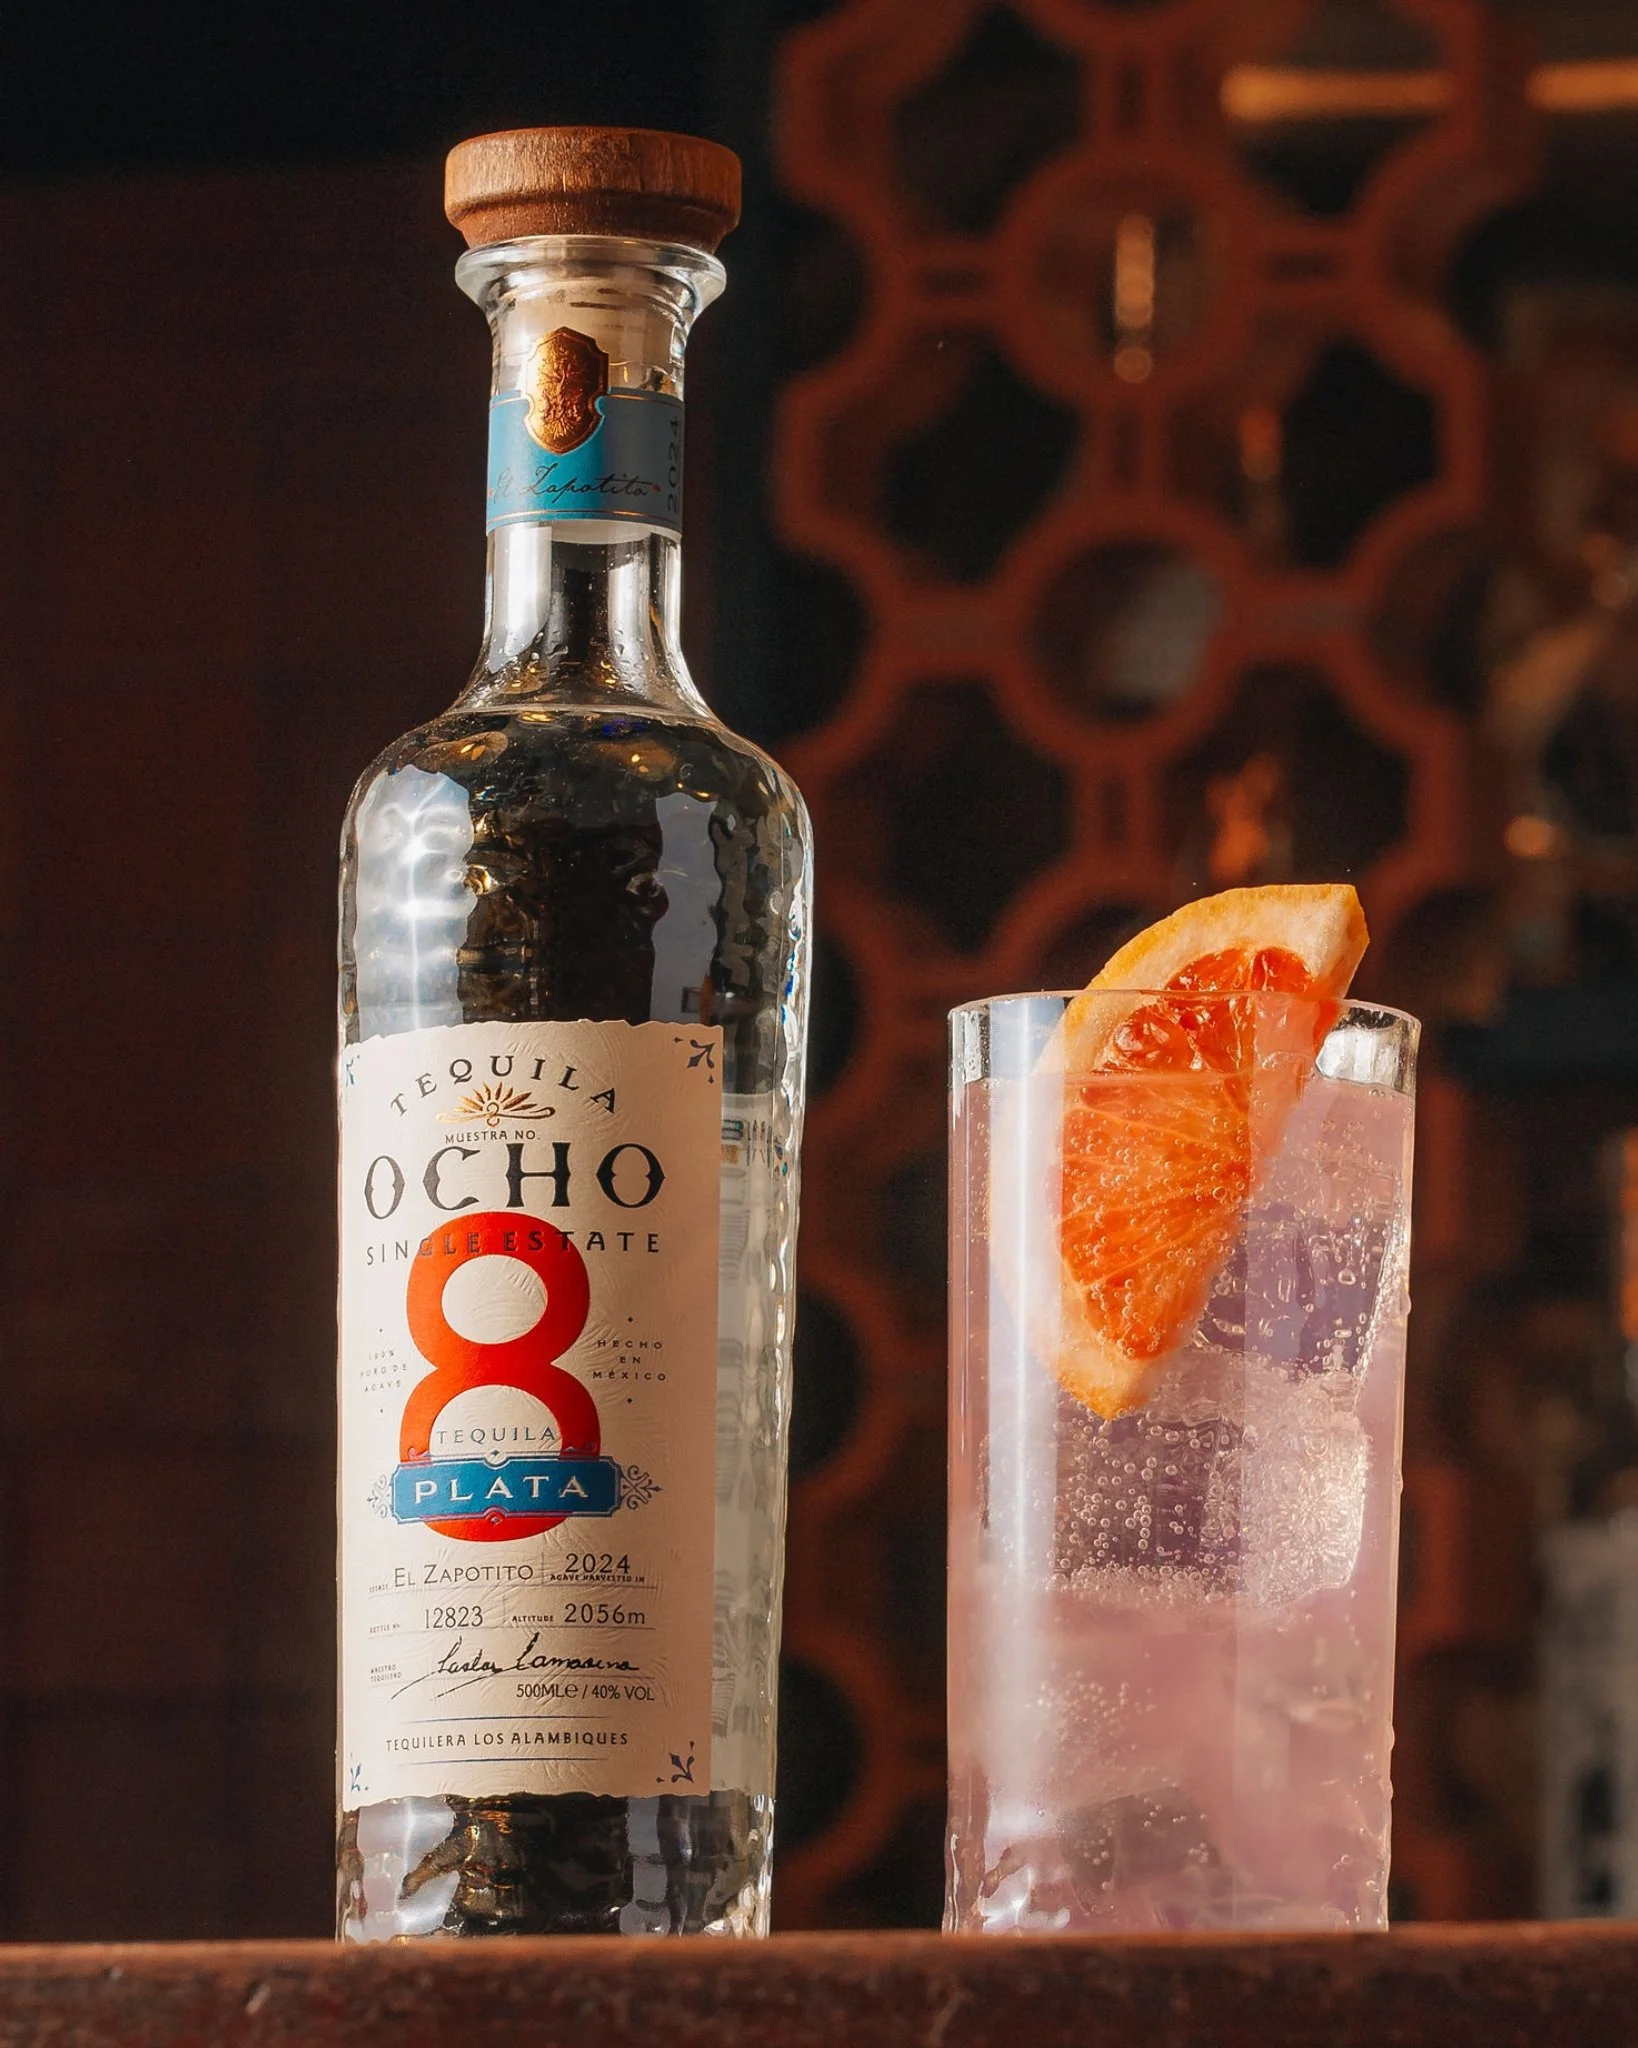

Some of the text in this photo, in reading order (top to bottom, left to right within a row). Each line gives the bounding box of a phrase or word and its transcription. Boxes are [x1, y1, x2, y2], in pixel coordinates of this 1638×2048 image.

[667, 416, 678, 514] 2024
[390, 1055, 616, 1117] TEQUILA
[445, 1130, 541, 1144] MUESTRA NO.
[364, 1143, 666, 1220] OCHO
[366, 1231, 660, 1266] SINGLE ESTATE
[597, 1339, 663, 1350] HECHO
[393, 1363, 408, 1372] DE
[619, 1356, 641, 1364] EN
[399, 1211, 601, 1542] 8
[592, 1370, 666, 1381] MÉXICO
[436, 1427, 557, 1445] TEQUILA
[414, 1475, 589, 1504] PLATA
[564, 1553, 631, 1574] 2024
[425, 1605, 484, 1629] 12823
[564, 1603, 646, 1625] 2056m
[591, 1685, 621, 1699] 40%
[624, 1685, 656, 1701] VOL
[386, 1732, 629, 1752] TEQUILERA LOS ALAMBIQUES
